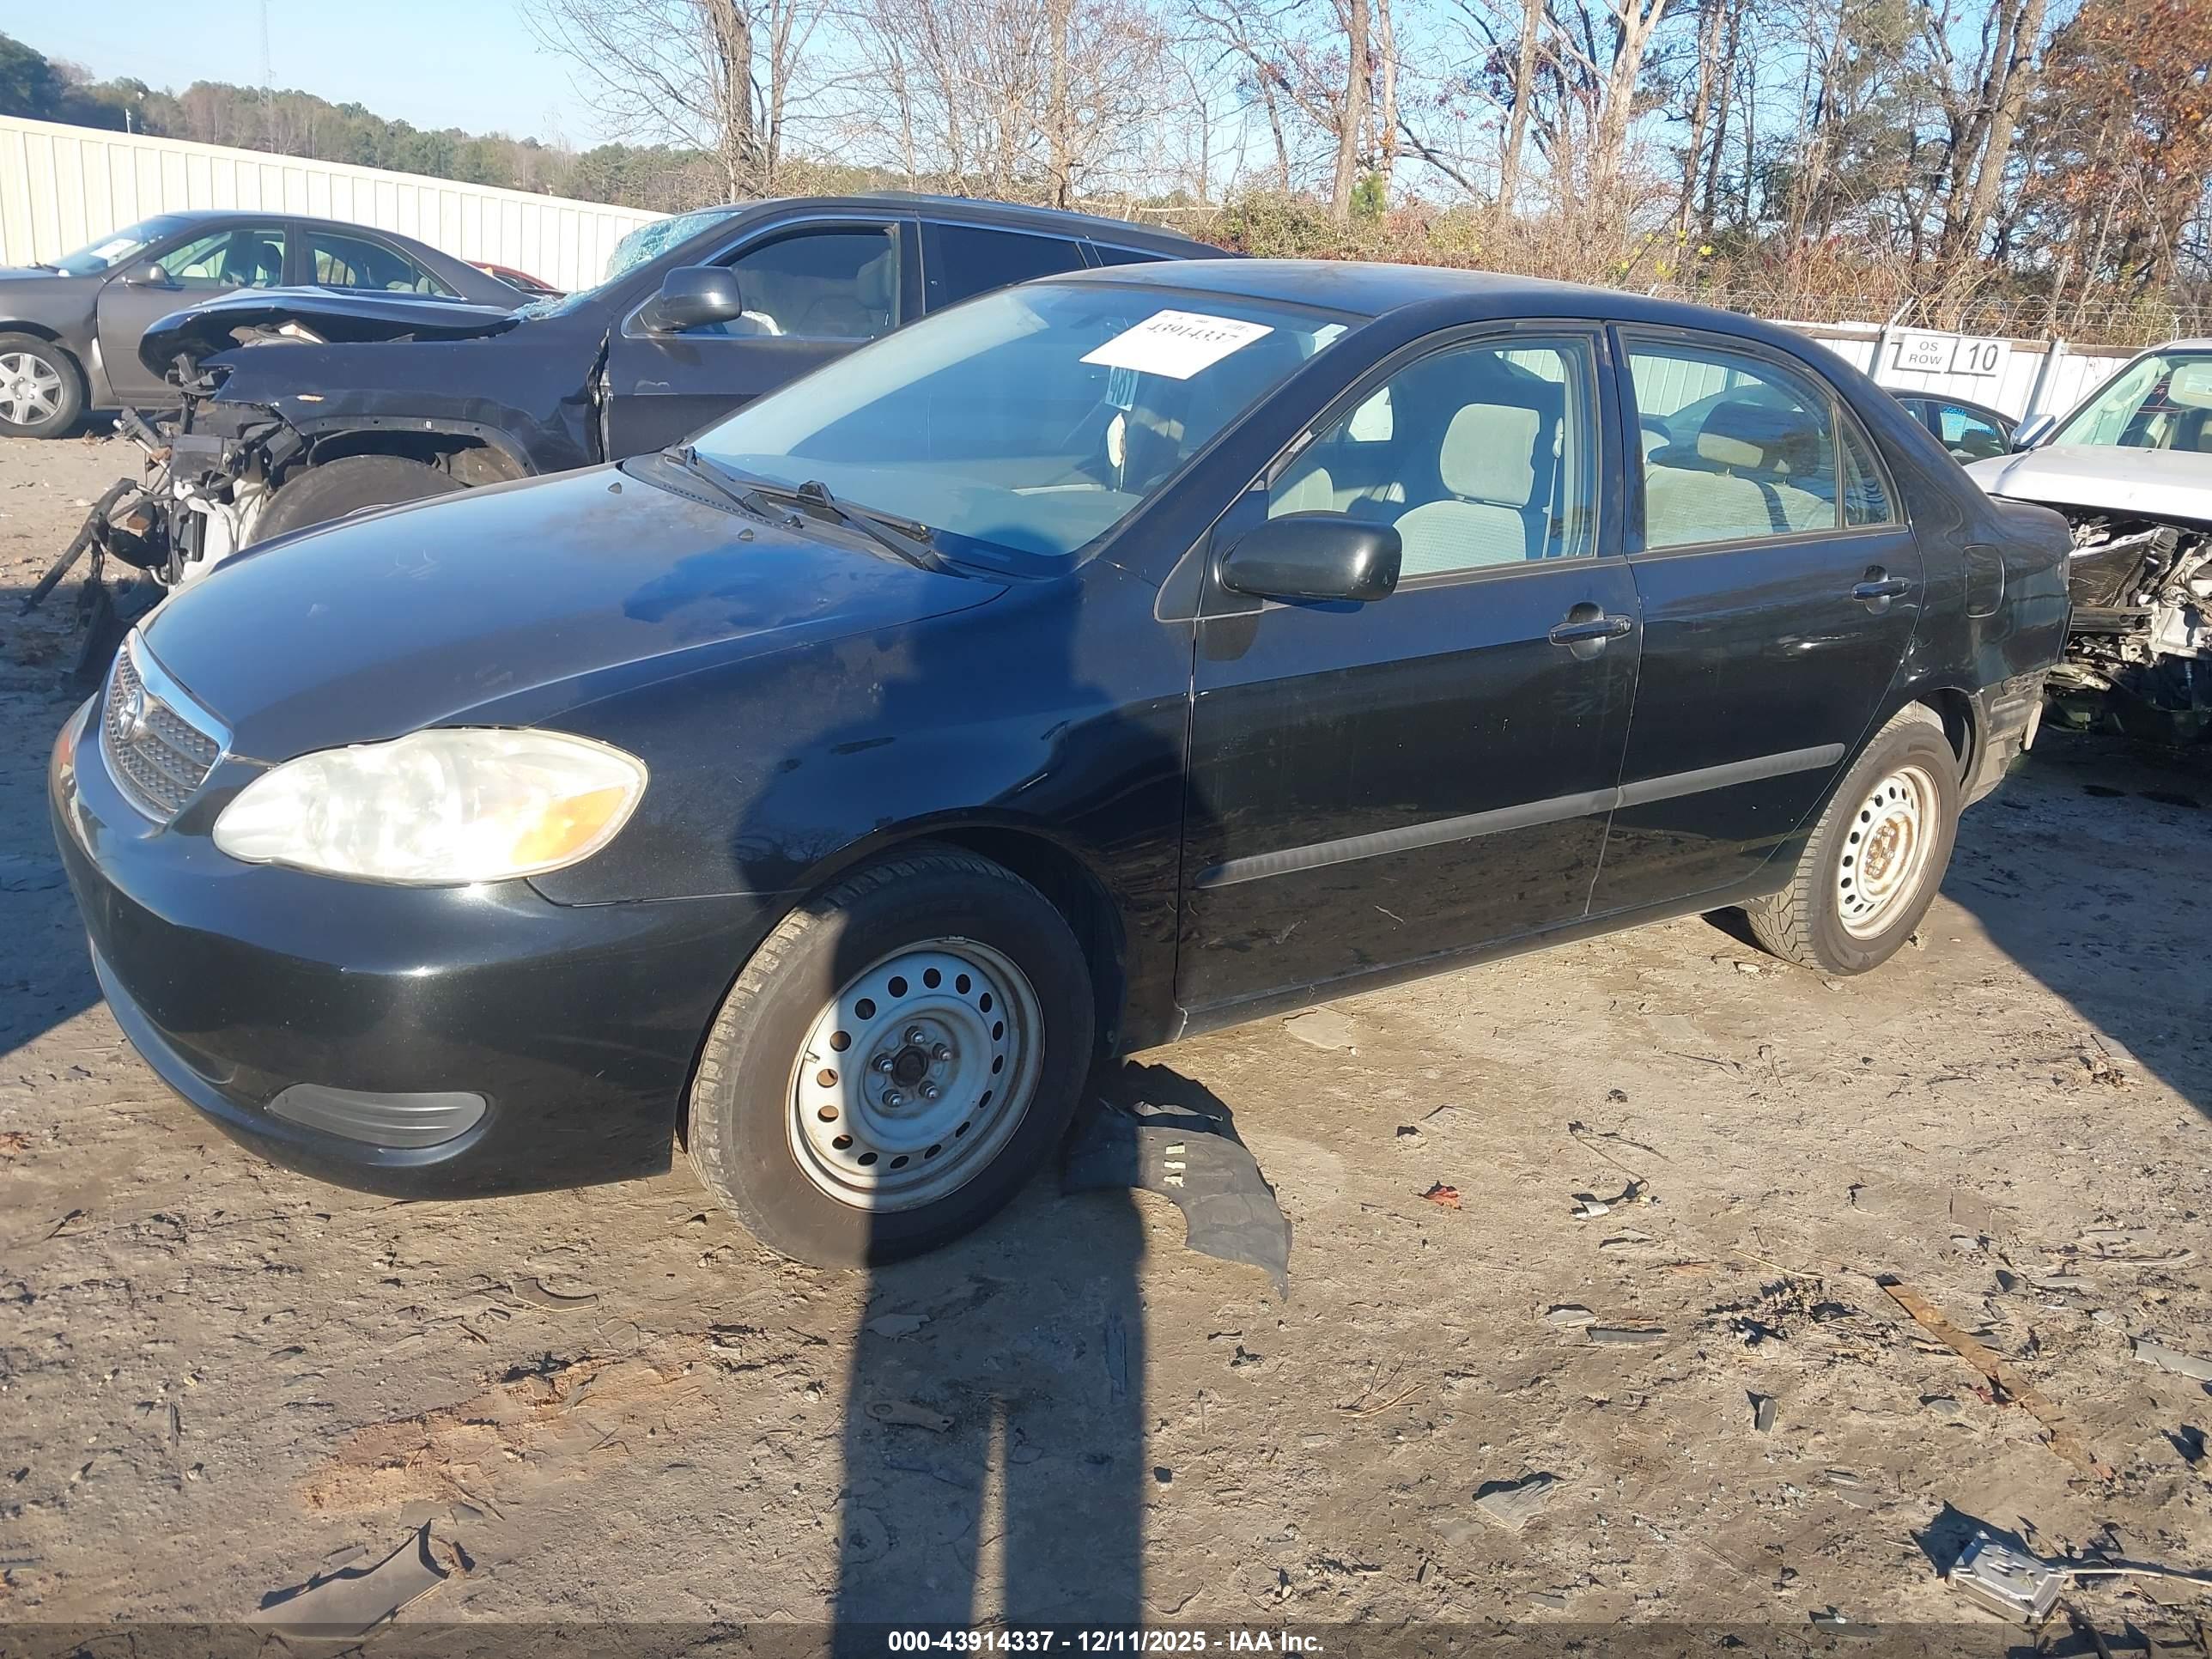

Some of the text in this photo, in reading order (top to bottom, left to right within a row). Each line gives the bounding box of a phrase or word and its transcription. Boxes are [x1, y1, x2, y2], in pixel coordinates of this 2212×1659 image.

[1919, 341, 1939, 352] OS
[1909, 353, 1943, 365] ROW
[1969, 342, 1999, 371] 10
